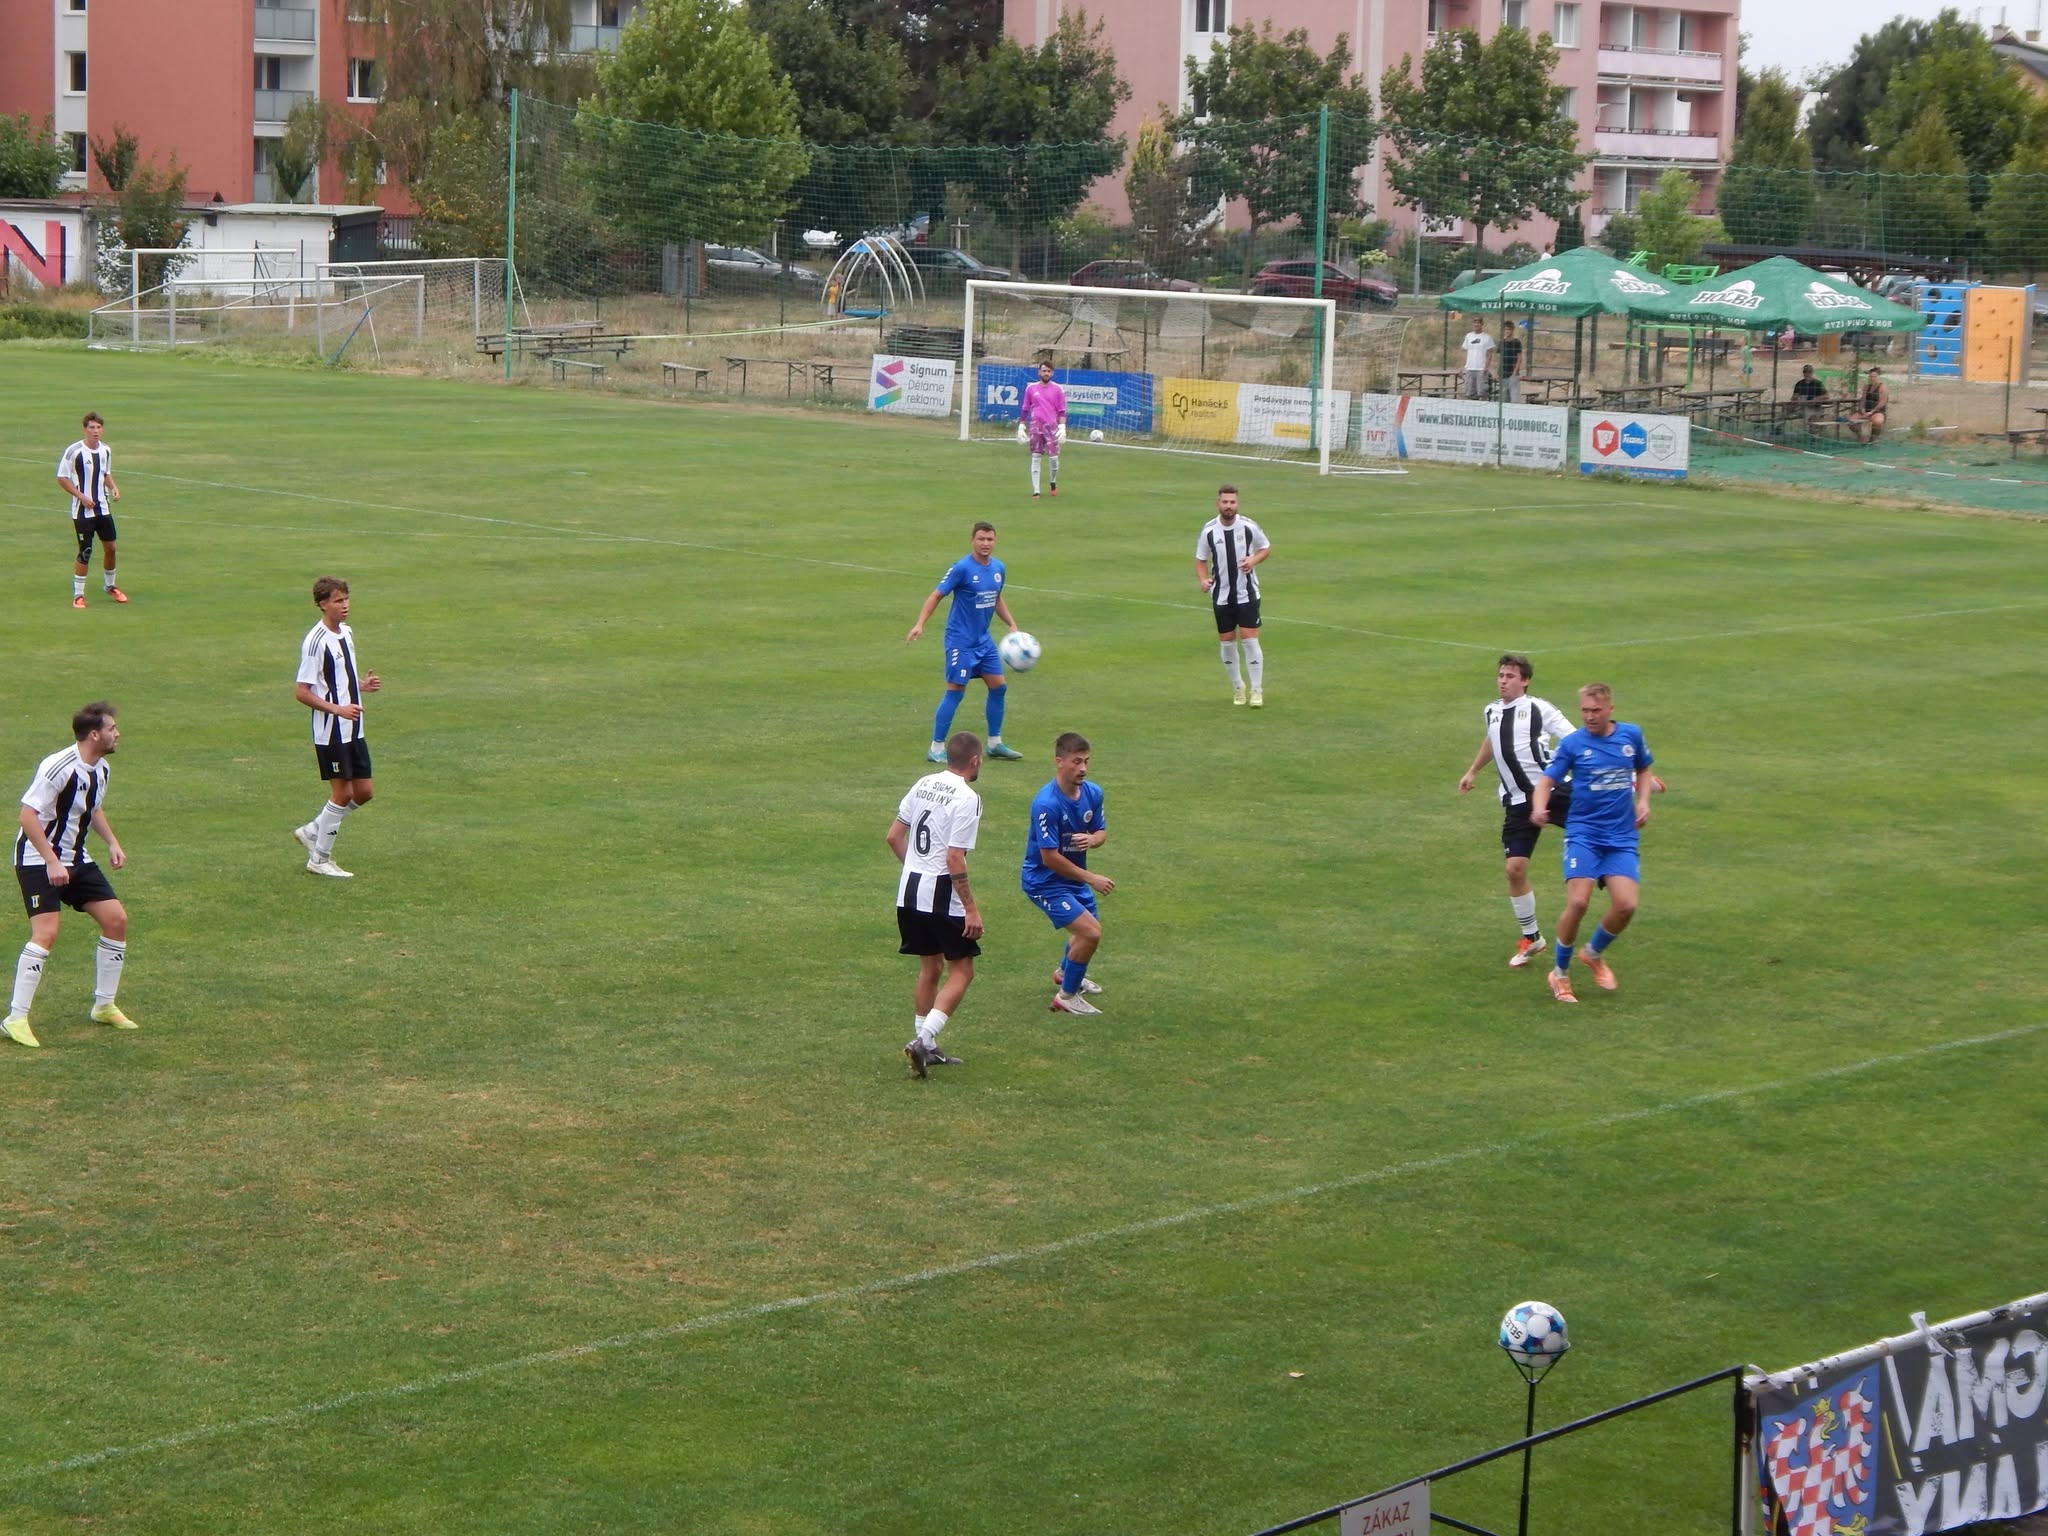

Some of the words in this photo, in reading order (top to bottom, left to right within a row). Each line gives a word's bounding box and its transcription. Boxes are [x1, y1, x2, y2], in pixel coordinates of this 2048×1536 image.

[1504, 280, 1569, 294] HOLBA
[1616, 279, 1665, 294] HOLBA
[1695, 291, 1762, 308] HOLBA
[1812, 293, 1867, 309] HOLBA
[1846, 319, 1867, 328] PIVO
[1868, 320, 1874, 328] Z
[1875, 319, 1893, 329] HOR
[909, 363, 948, 378] Signum
[905, 393, 945, 406] reklamu
[986, 384, 1019, 406] K2
[1102, 388, 1115, 401] K2
[1365, 429, 1388, 442] IVT
[932, 781, 957, 795] SIGMA
[915, 809, 932, 858] 6
[1570, 858, 1577, 868] 5
[1062, 901, 1070, 911] 9
[1362, 1500, 1411, 1536] ZÁKAZ
